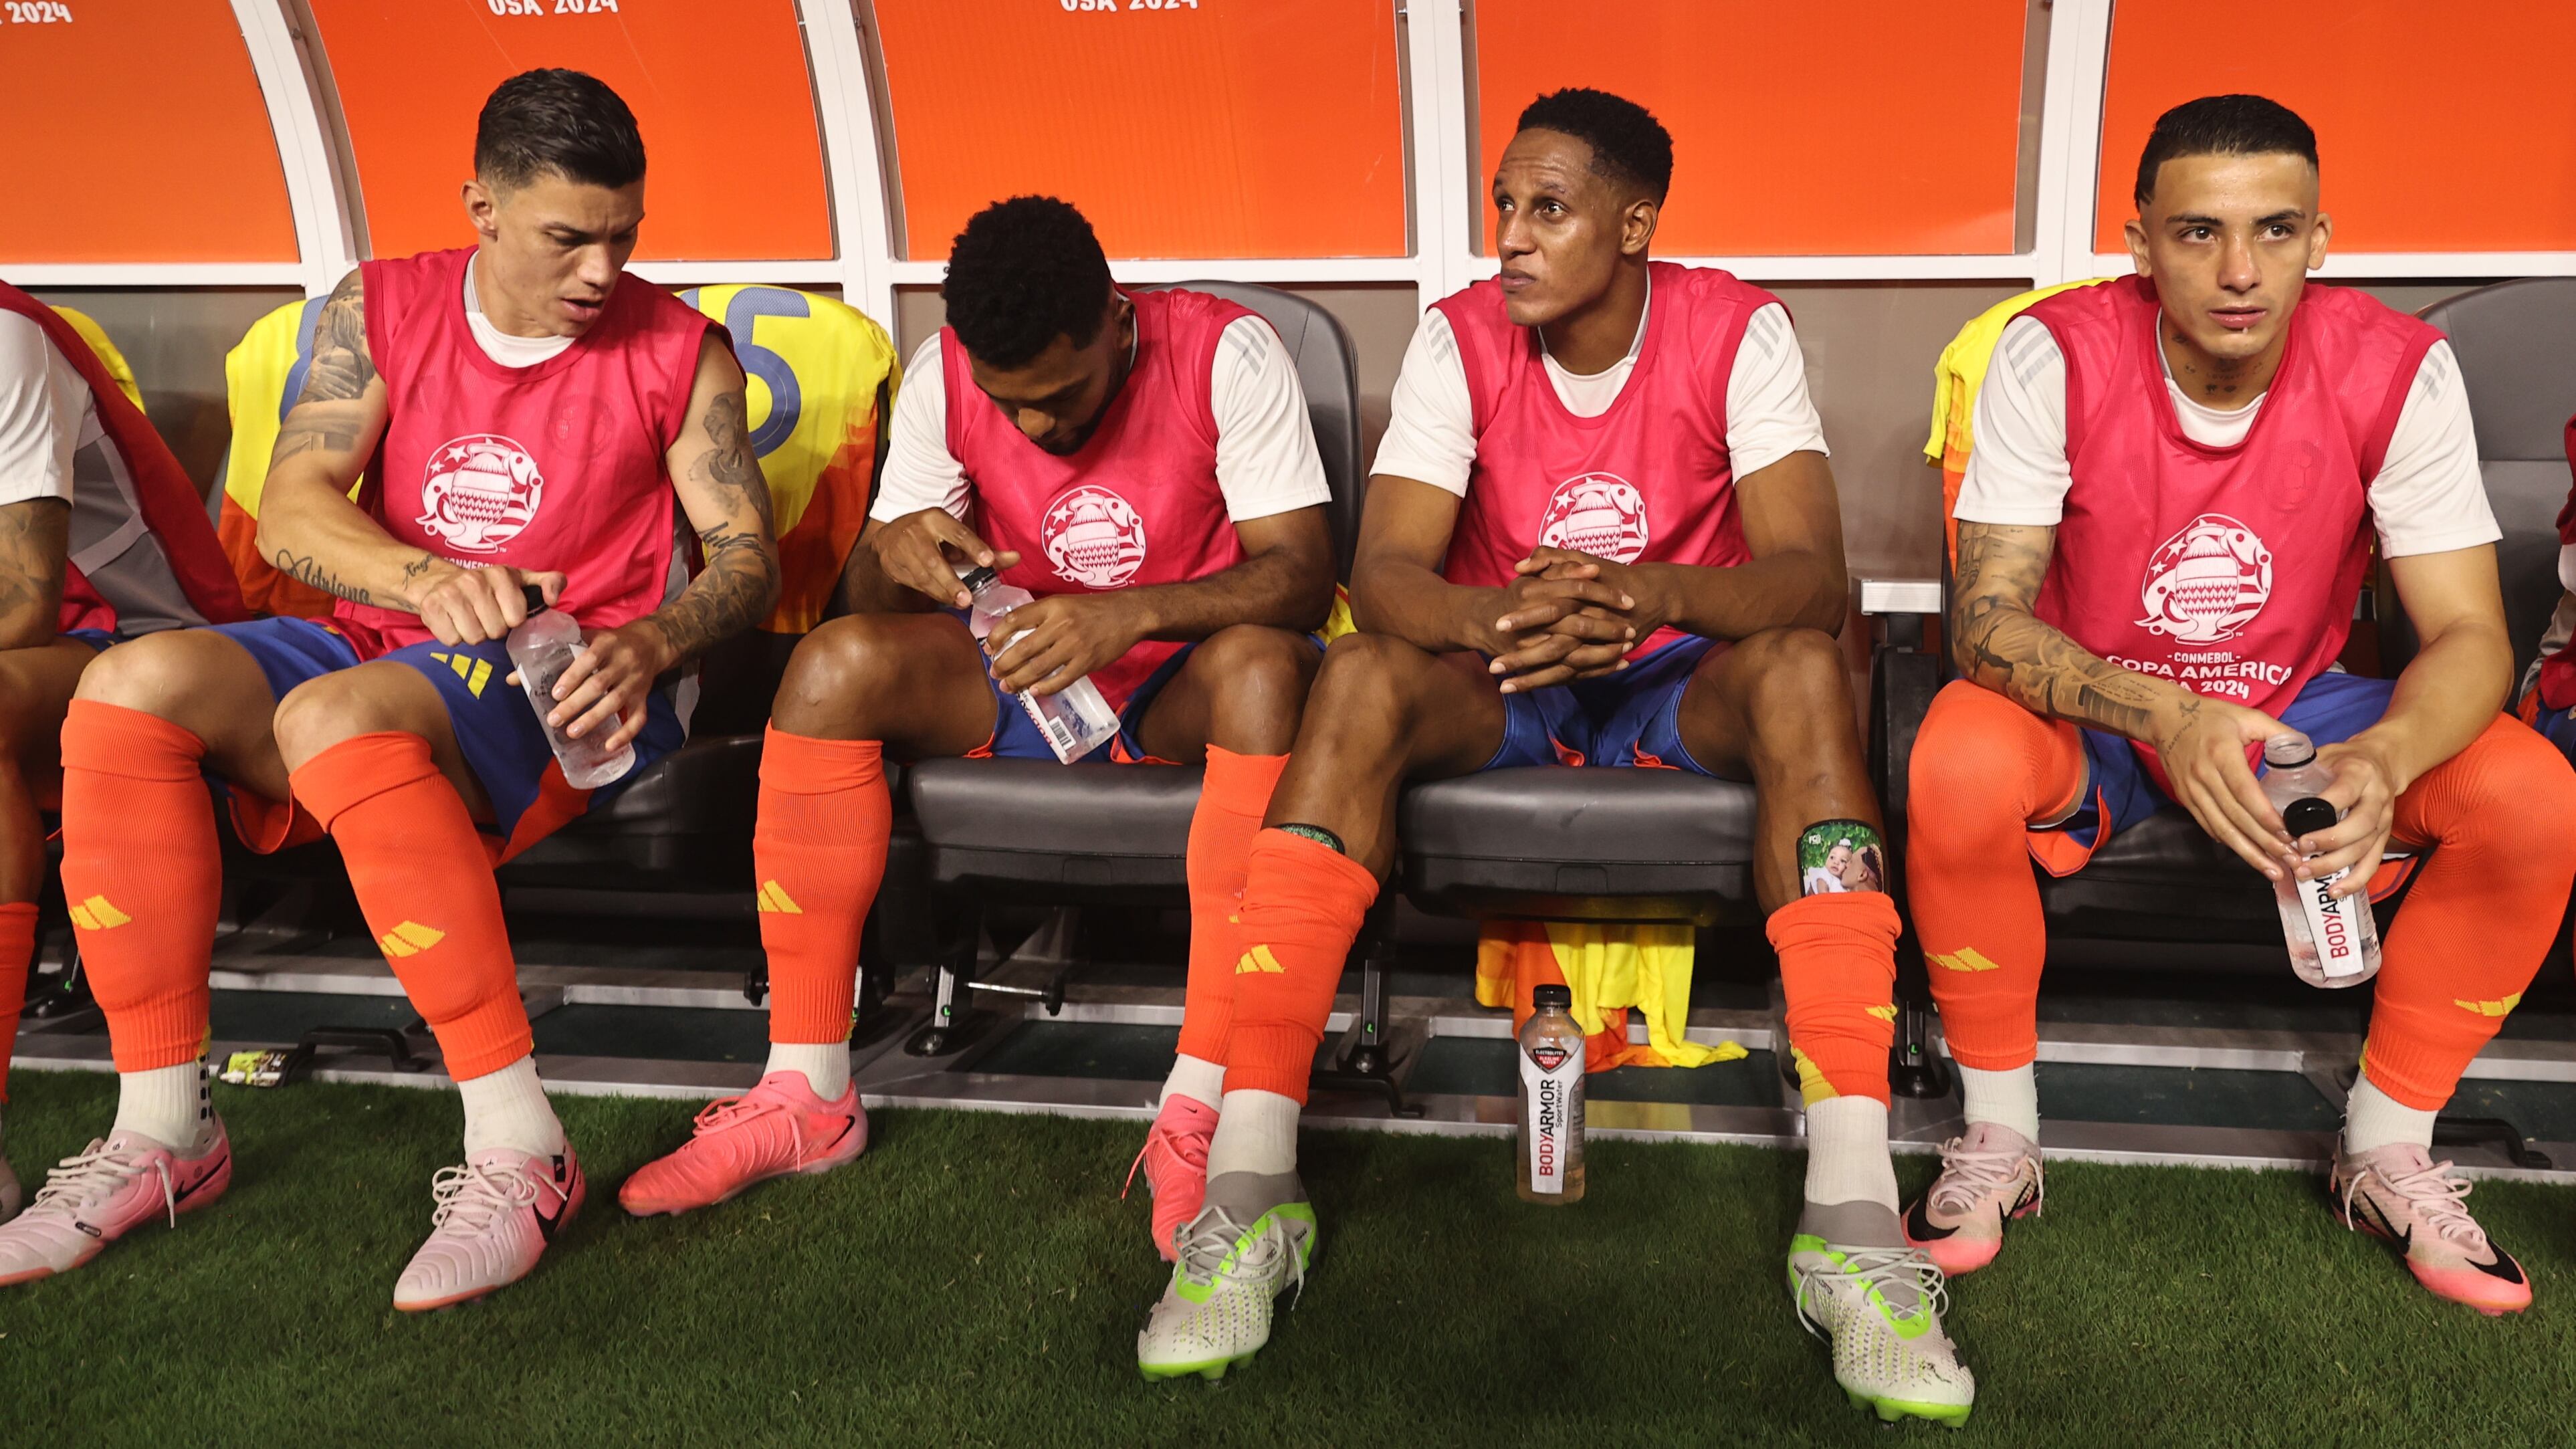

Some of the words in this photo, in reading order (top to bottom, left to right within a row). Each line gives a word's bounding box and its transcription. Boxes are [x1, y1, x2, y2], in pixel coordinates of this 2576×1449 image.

[5, 1, 73, 23] 2024
[2107, 655, 2175, 677] COPA
[2180, 661, 2292, 685] AMERICA
[2201, 679, 2249, 699] 2024
[2309, 851, 2349, 959] BODYARM
[1539, 1079, 1555, 1177] BODYARMOR
